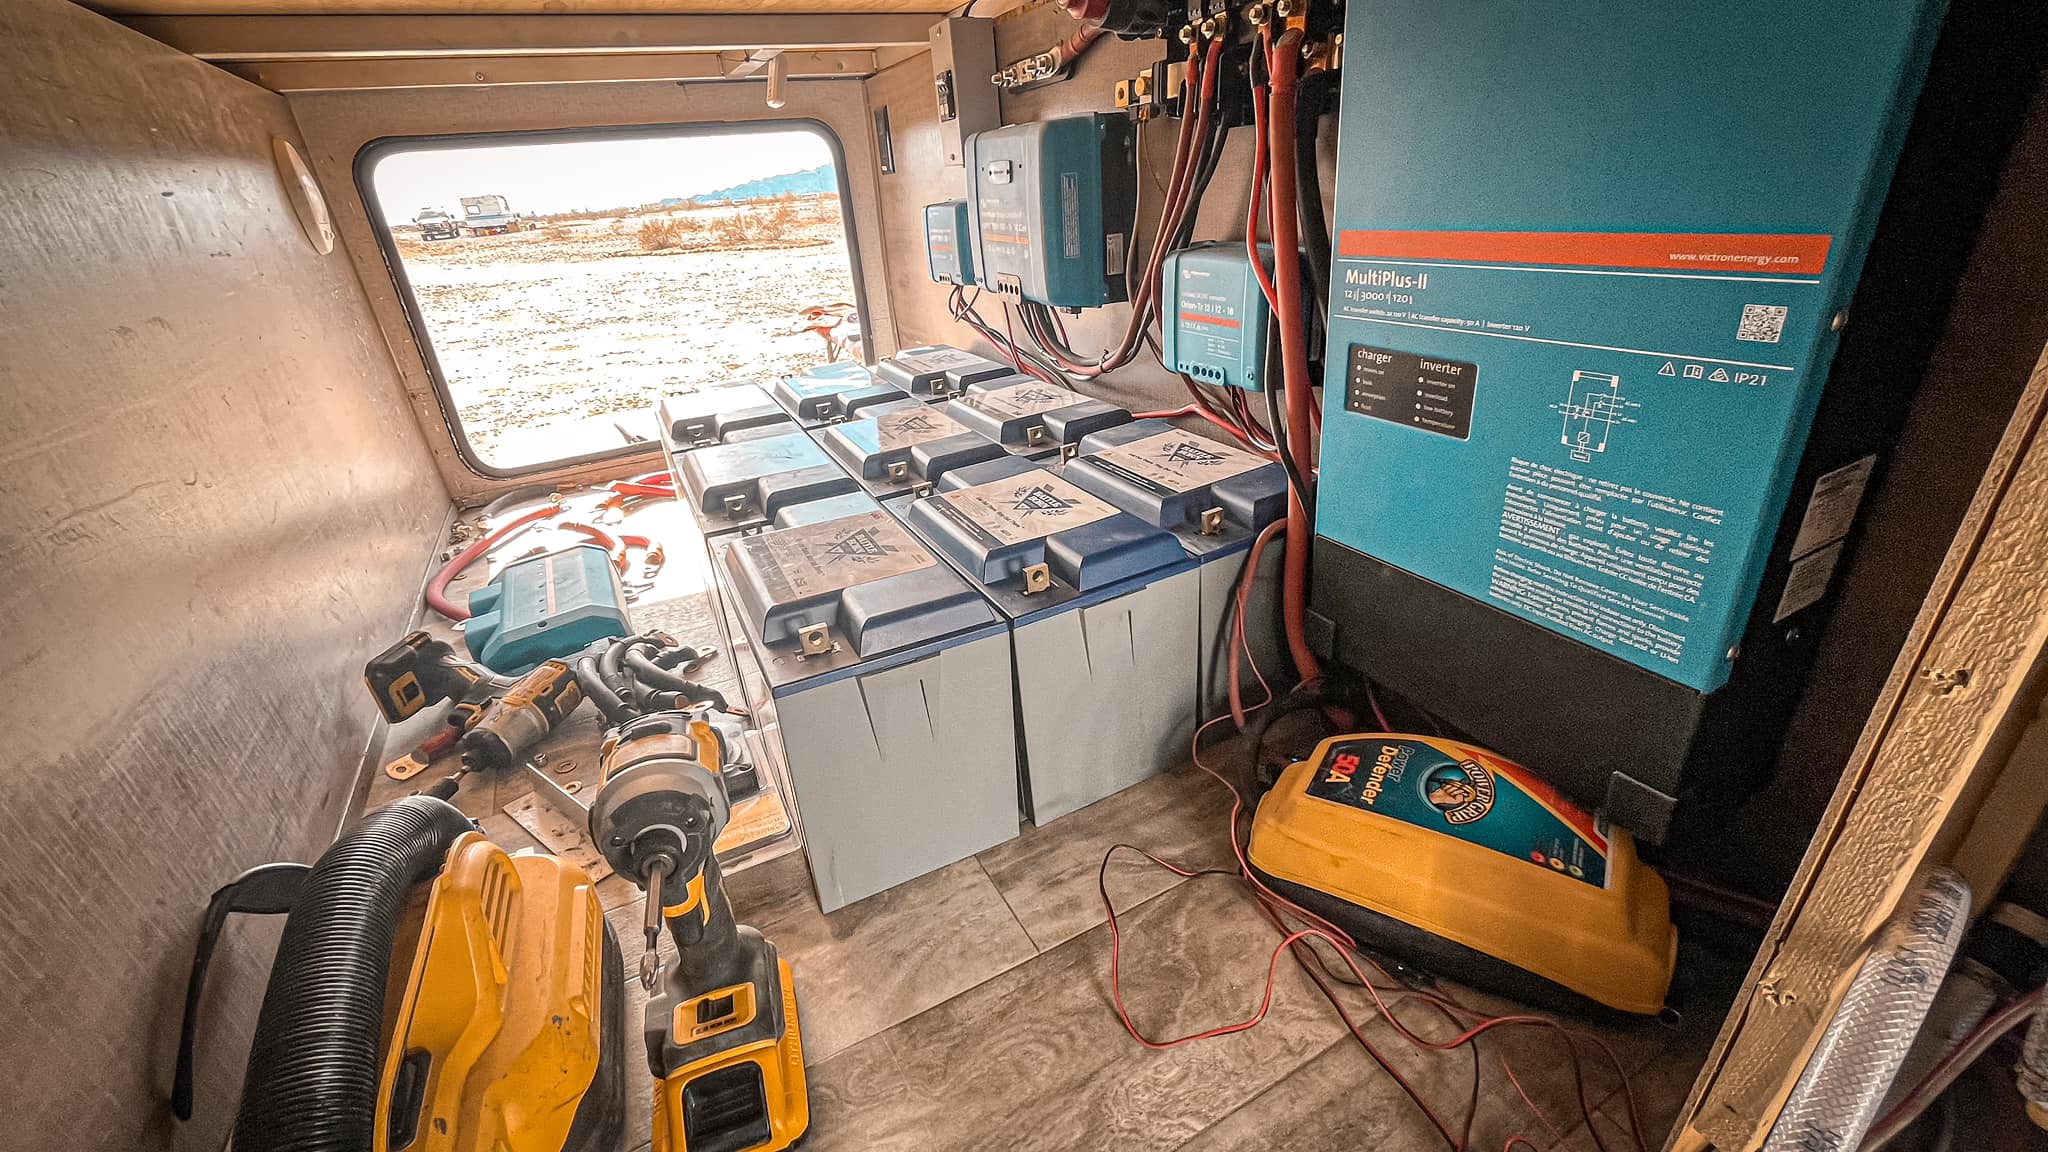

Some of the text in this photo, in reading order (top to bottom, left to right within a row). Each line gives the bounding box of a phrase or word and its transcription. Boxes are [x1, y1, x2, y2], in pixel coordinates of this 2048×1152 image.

[1669, 252, 1800, 266] www.victronenergy.com
[1345, 269, 1429, 290] MultiPlus-II
[1357, 348, 1392, 365] charger
[1420, 358, 1463, 376] inverter
[1734, 372, 1768, 387] IP21
[1325, 753, 1361, 785] 50A
[1388, 744, 1416, 783] Power
[1360, 745, 1399, 805] Defender
[1452, 801, 1486, 821] GRIP
